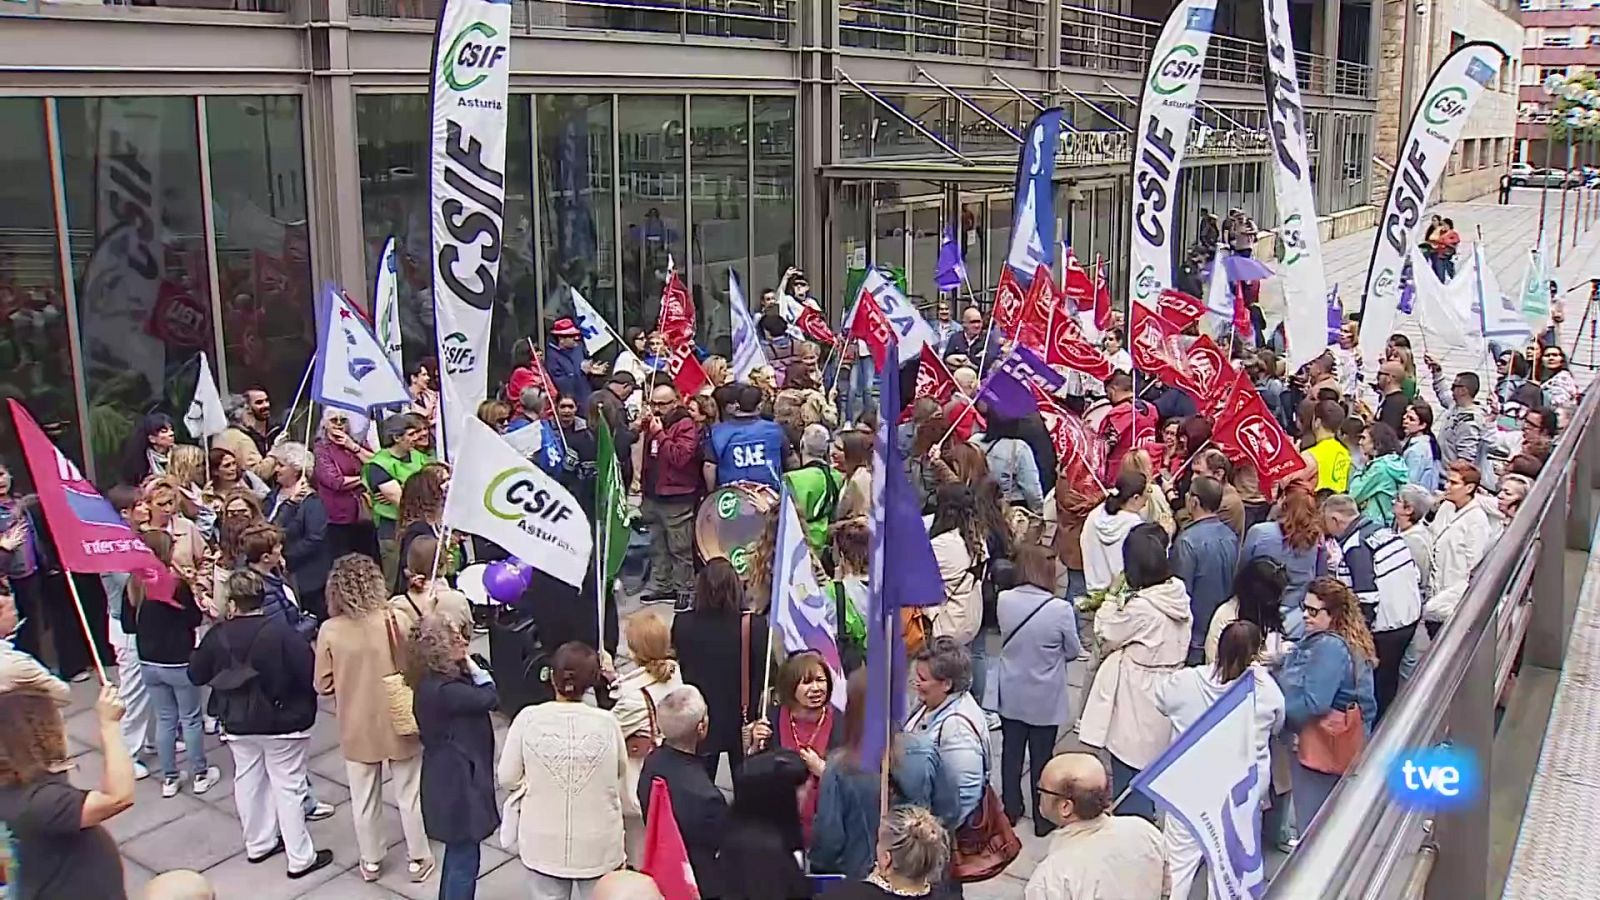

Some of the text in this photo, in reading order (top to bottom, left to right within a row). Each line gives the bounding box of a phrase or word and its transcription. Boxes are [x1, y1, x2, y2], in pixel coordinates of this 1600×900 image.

[457, 41, 506, 69] CSIF
[1161, 58, 1202, 79] CSIF
[1434, 96, 1466, 118] CSIF
[1135, 114, 1177, 247] CSIF
[1386, 137, 1431, 257] CSIF
[444, 119, 504, 310] CSIF
[506, 479, 573, 525] CSIF
